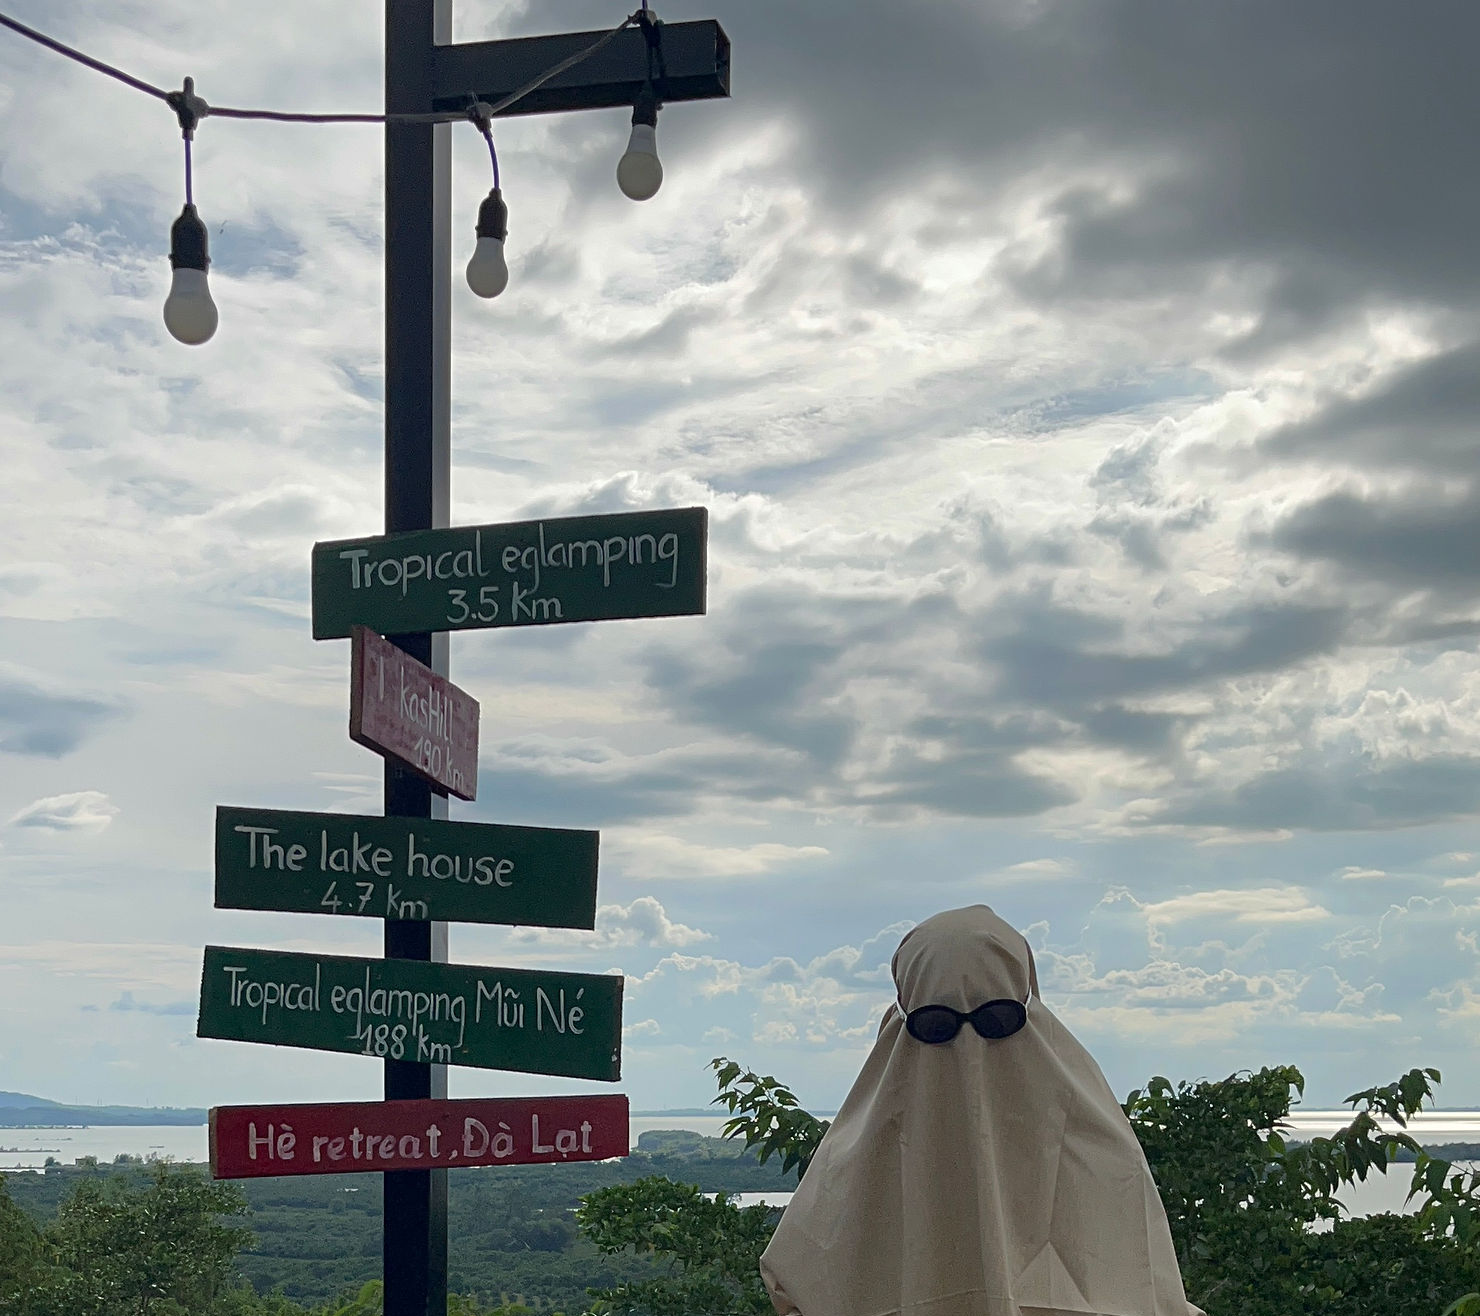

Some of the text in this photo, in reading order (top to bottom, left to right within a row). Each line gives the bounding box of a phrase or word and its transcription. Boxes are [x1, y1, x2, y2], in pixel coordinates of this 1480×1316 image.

[339, 522, 679, 597] Tropical eglamping
[446, 586, 500, 624] 3.5
[234, 825, 515, 887] The lake house
[320, 881, 374, 915] 4.7
[223, 963, 584, 1049] Tropical eglamping Mũi Né
[360, 1023, 404, 1058] 188
[248, 1121, 295, 1160] Hè
[531, 1113, 592, 1158] Lạt
